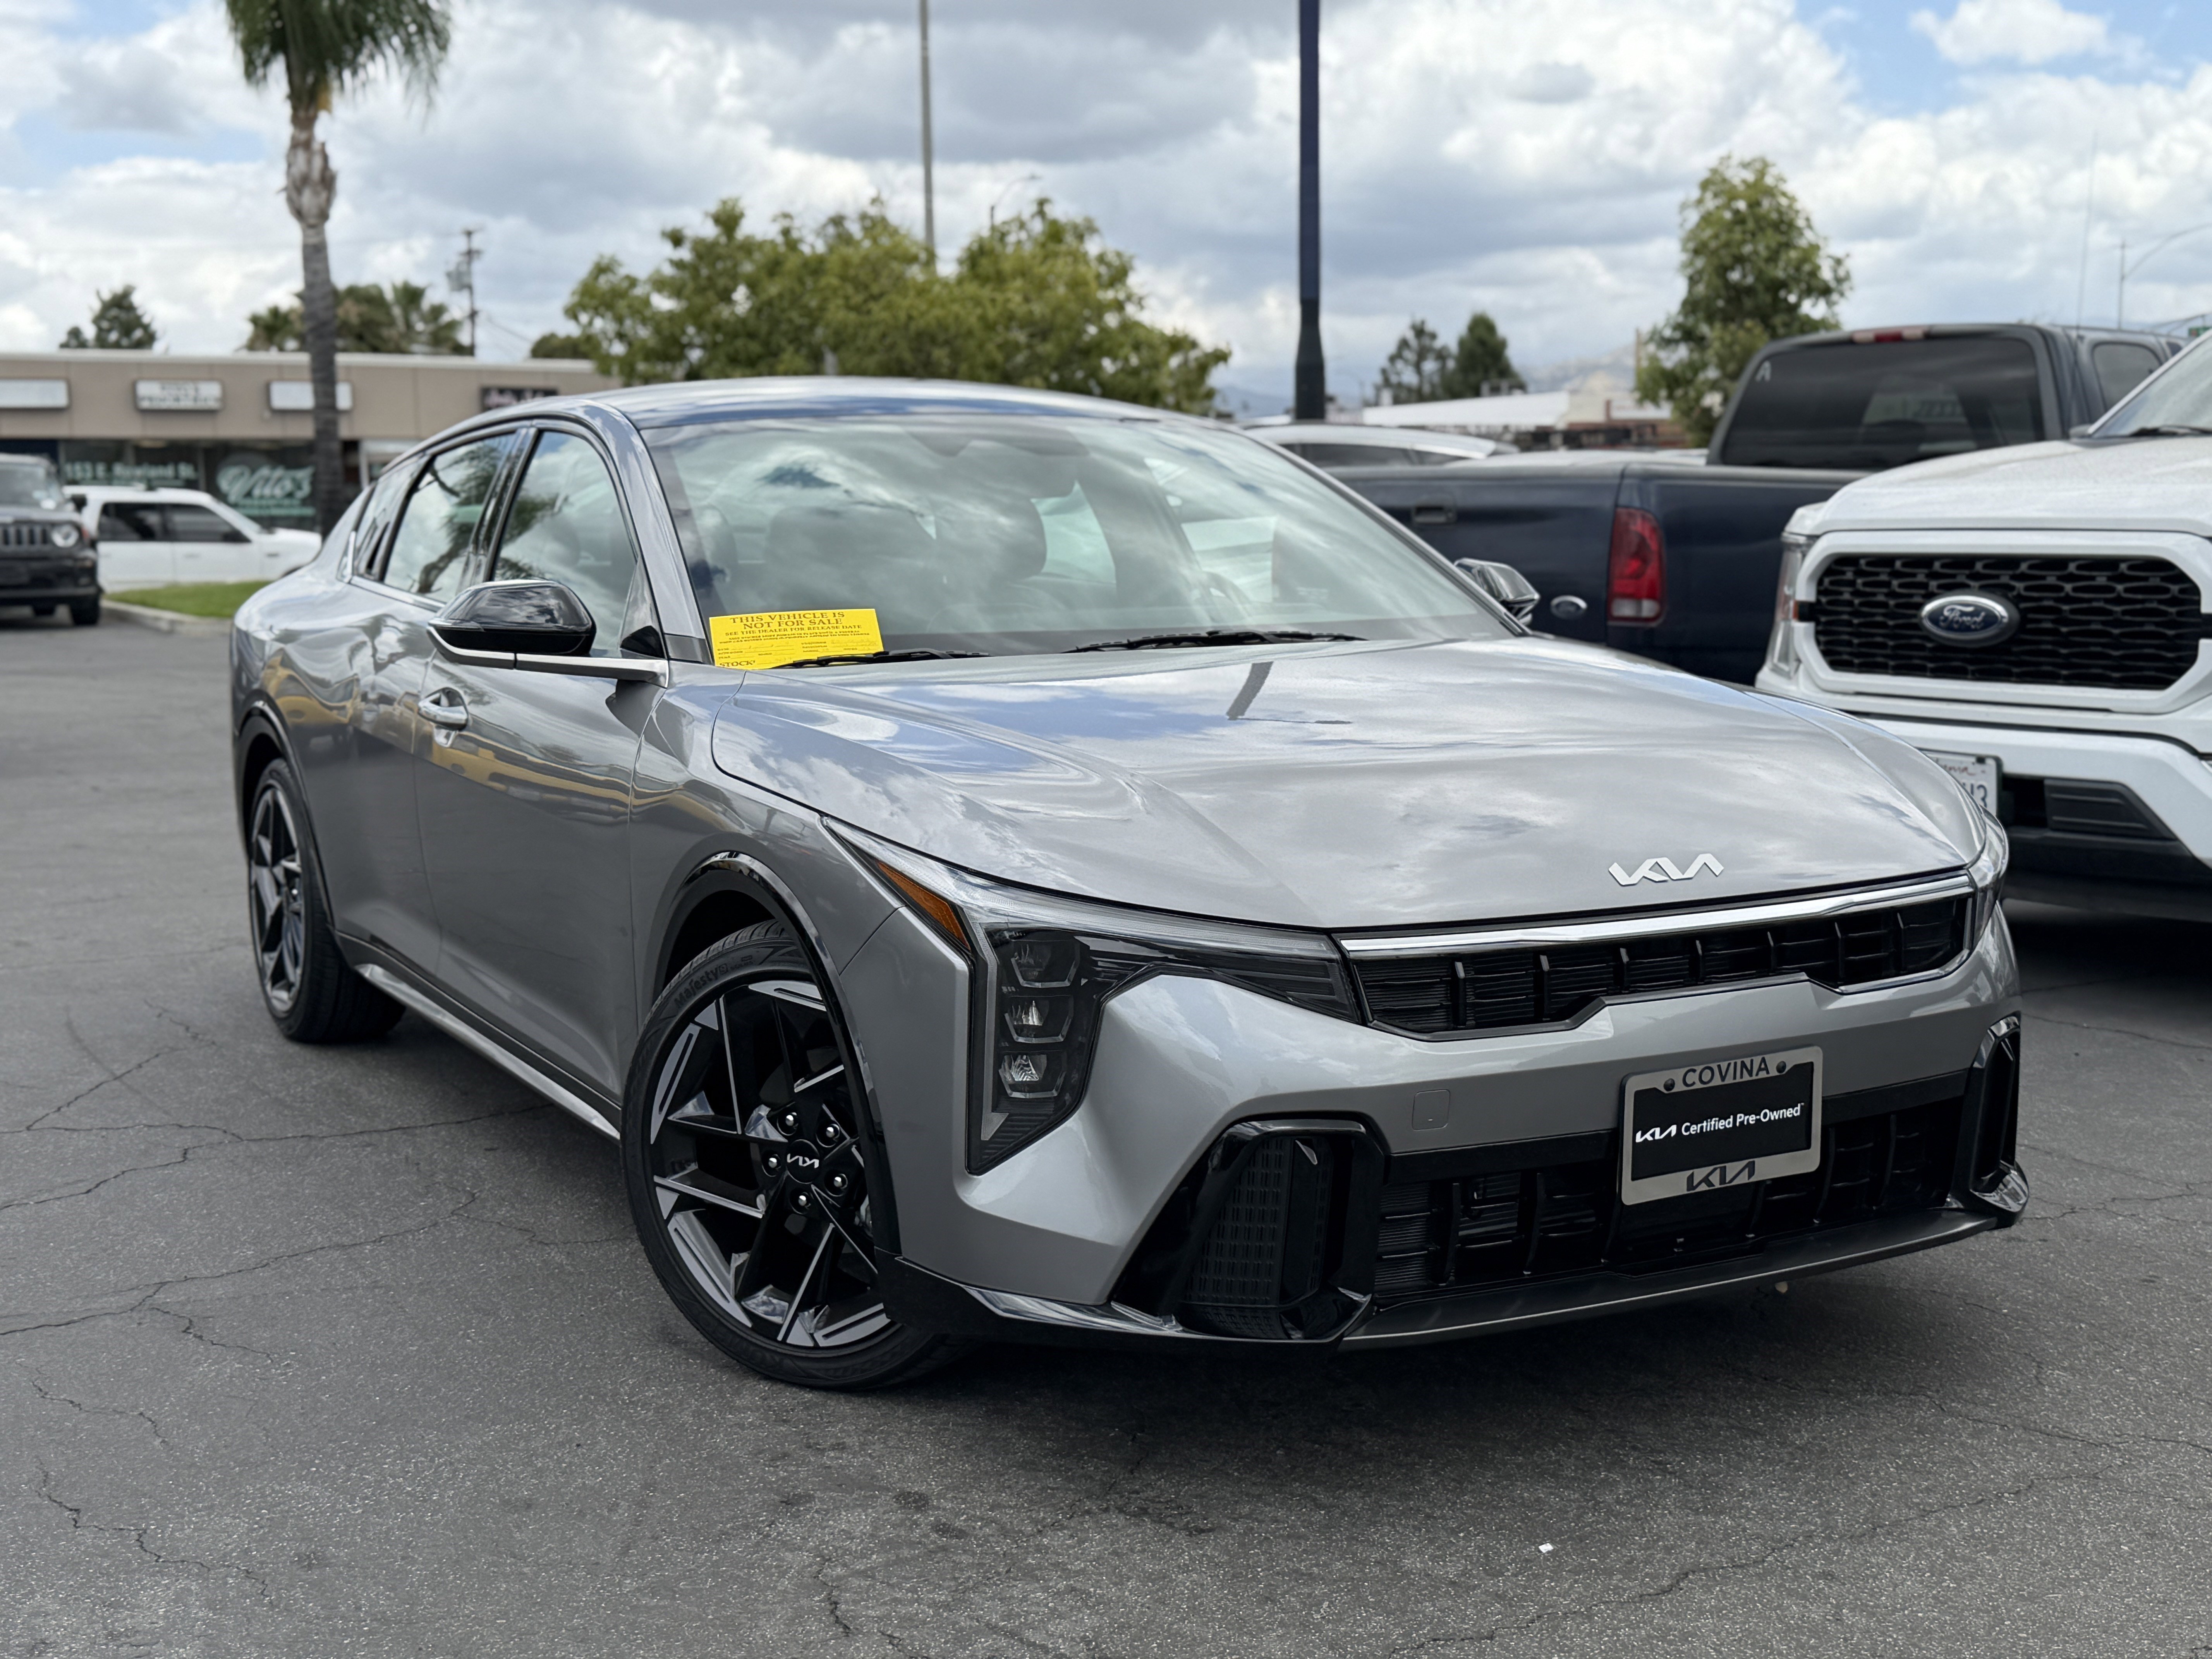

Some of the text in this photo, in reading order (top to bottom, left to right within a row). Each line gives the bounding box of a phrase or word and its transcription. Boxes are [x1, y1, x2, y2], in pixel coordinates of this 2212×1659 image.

[1939, 605, 1986, 629] Ford
[1609, 853, 1724, 886] KIA
[1682, 1056, 1770, 1088] COVINA
[1635, 1125, 1677, 1143] KIA
[1681, 1115, 1734, 1136] Certified
[787, 1153, 819, 1169] KIA
[1686, 1160, 1755, 1192] KIA
